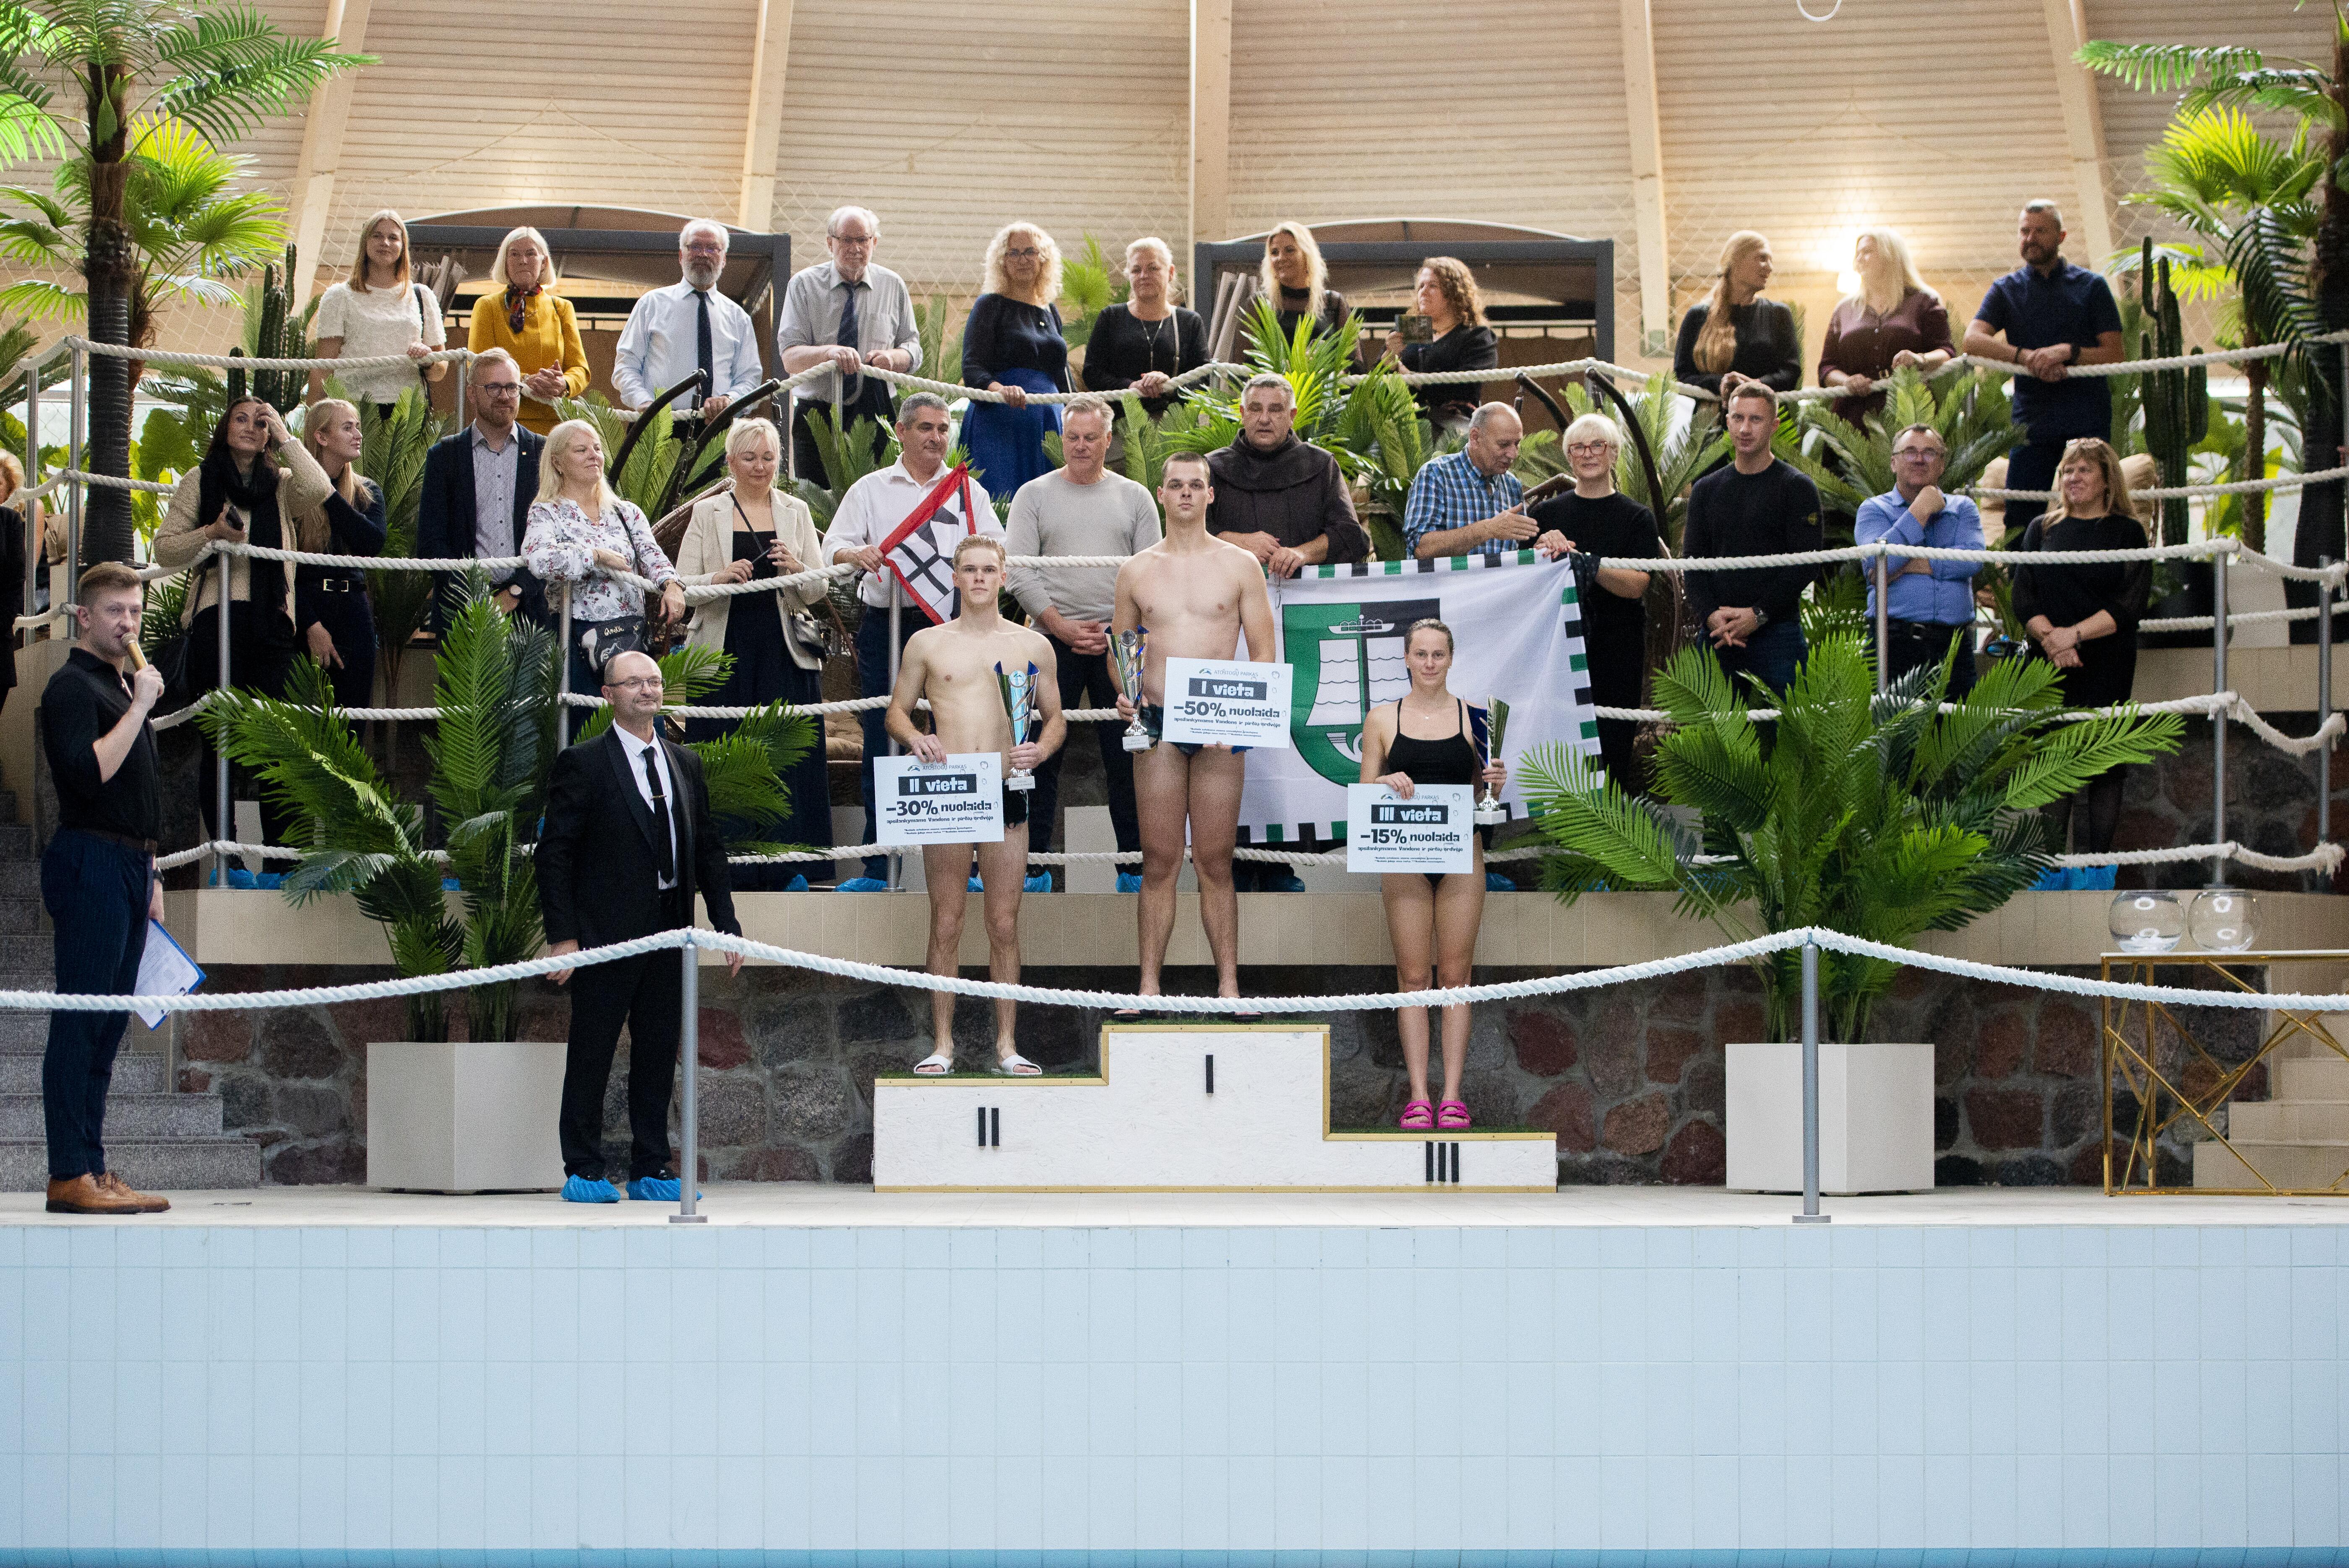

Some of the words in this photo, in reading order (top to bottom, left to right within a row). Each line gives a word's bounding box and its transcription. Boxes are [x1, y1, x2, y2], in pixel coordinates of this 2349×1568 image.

[1201, 681, 1207, 694] I
[1212, 683, 1254, 697] vieta
[1174, 701, 1226, 717] -50%
[1229, 707, 1280, 718] nuolaida
[910, 778, 919, 792] II
[926, 777, 967, 792] vieta
[886, 800, 938, 816] -30%
[941, 800, 992, 812] nuolaida
[1379, 807, 1394, 821] III
[1400, 807, 1441, 821] vieta
[1361, 829, 1406, 844] -15%
[1410, 832, 1460, 841] nuolaida
